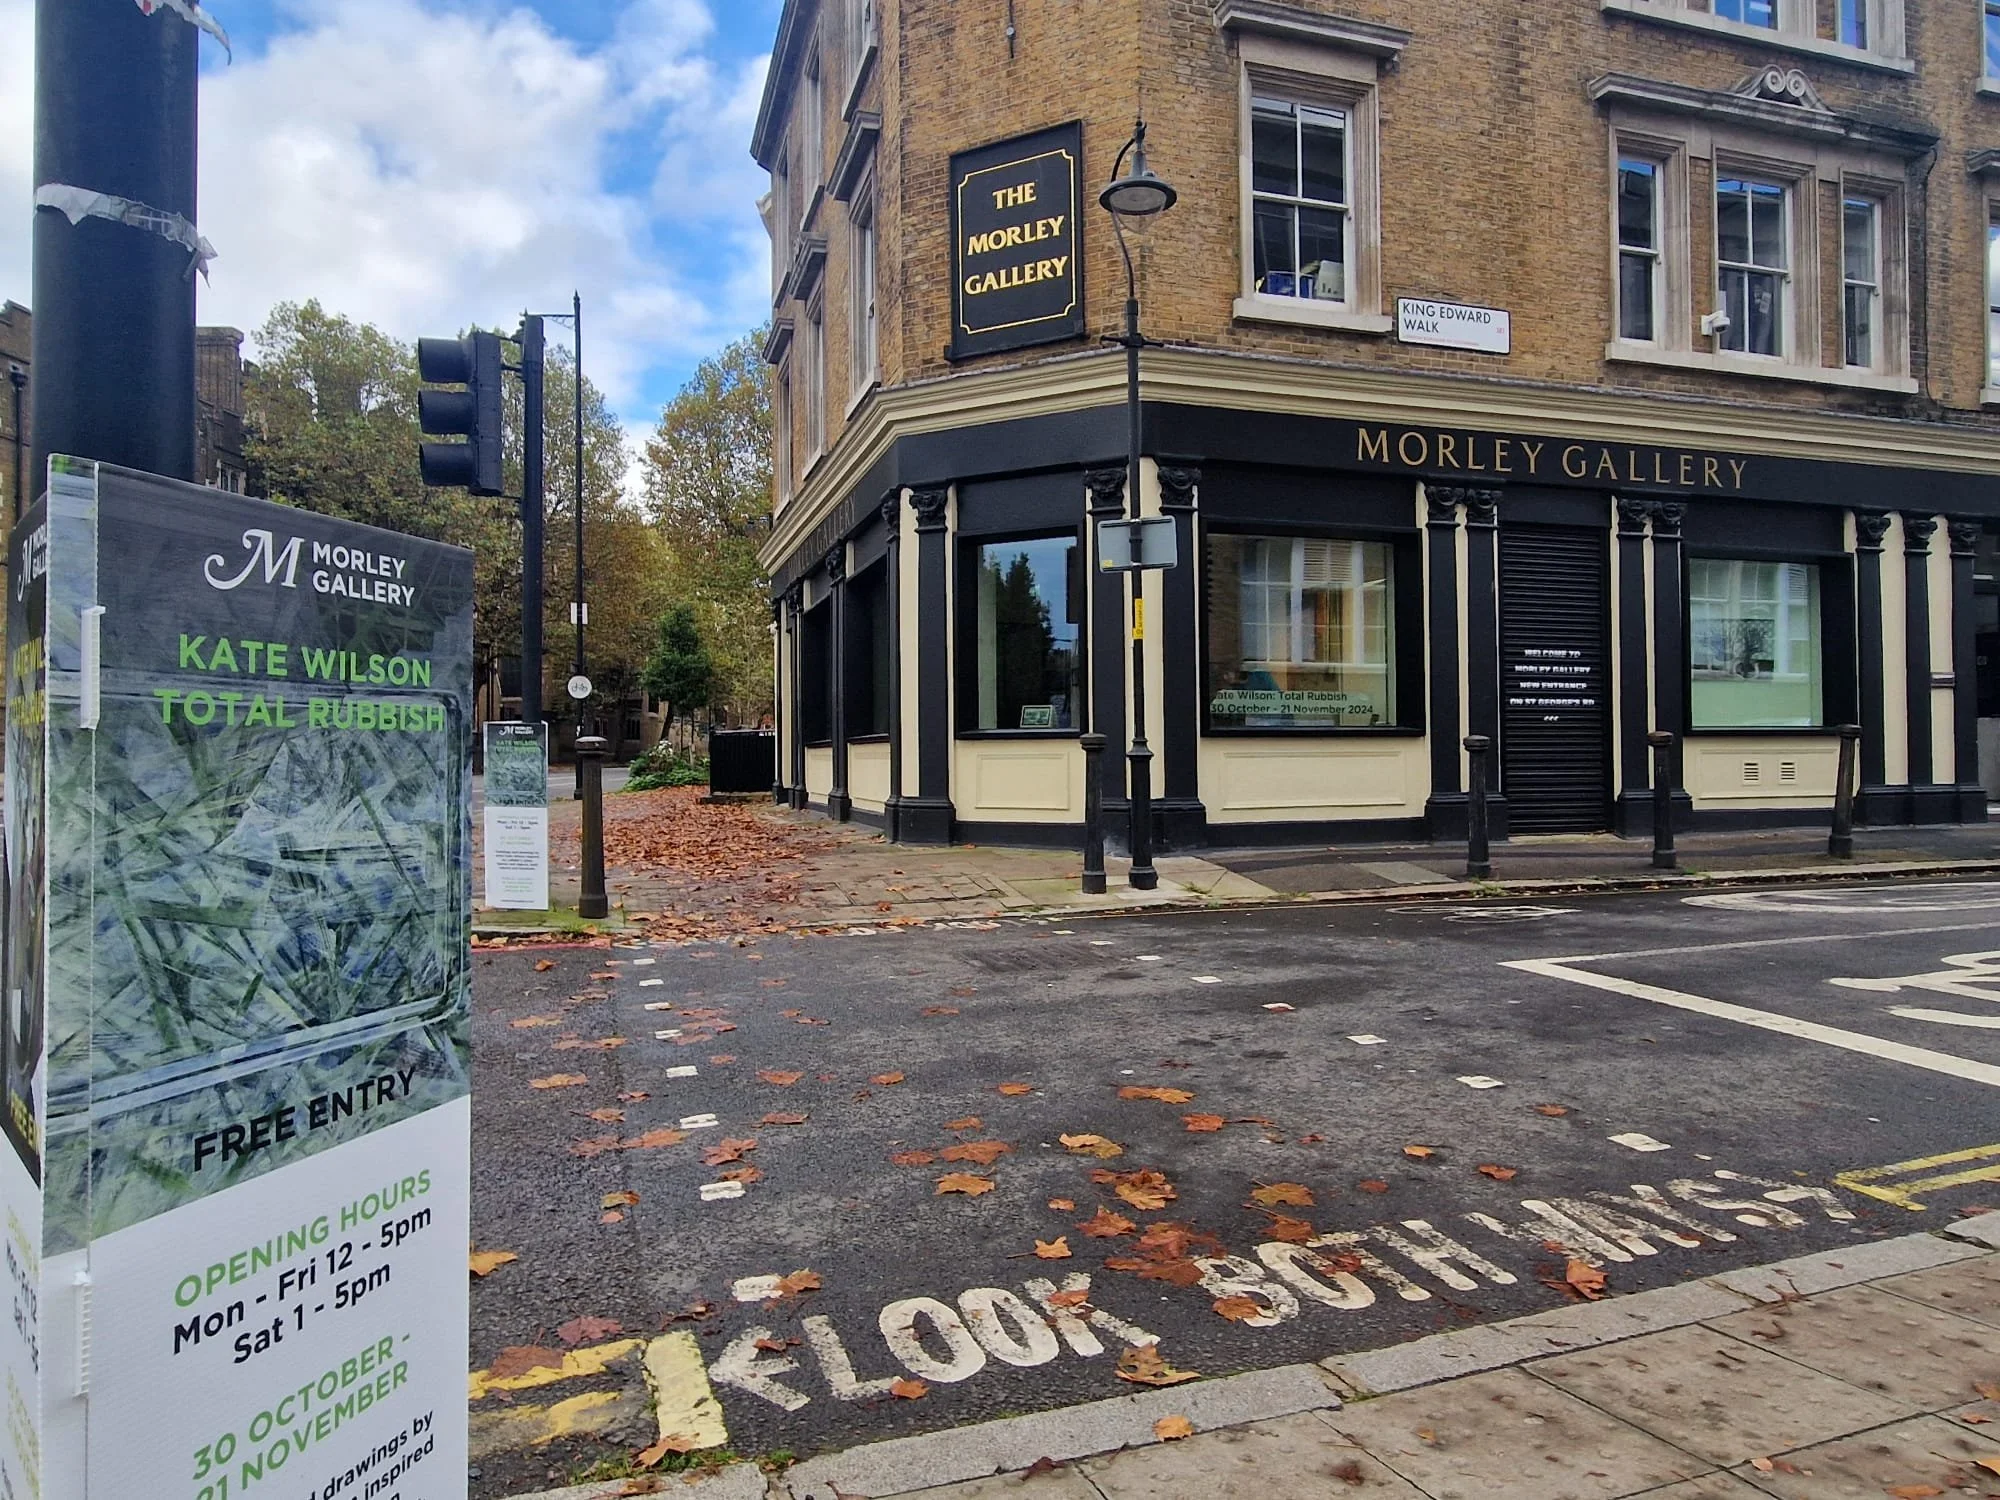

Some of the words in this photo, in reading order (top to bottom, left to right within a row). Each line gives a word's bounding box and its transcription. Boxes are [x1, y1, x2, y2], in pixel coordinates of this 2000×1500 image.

[992, 182, 1037, 210] THE
[967, 215, 1065, 256] MORLEY
[964, 255, 1069, 295] GALLERY
[1403, 302, 1436, 318] KING
[1440, 306, 1491, 324] EDWARD
[1404, 318, 1439, 333] WALK
[1356, 427, 1543, 474] MORLEY
[1561, 444, 1748, 489] GALLERY
[816, 491, 857, 556] GALLERY
[312, 541, 406, 579] MORLEY
[312, 569, 415, 607] GALLERY
[178, 633, 289, 677] KATE
[301, 646, 431, 688] WILSON
[153, 688, 296, 729] TOTAL
[308, 697, 444, 733] RUBBISH
[1211, 703, 1225, 713] 30
[1228, 704, 1270, 713] October
[1280, 704, 1291, 713] 21
[1294, 704, 1345, 714] November
[1349, 705, 1374, 714] 2024
[1217, 692, 1234, 700] ate
[1238, 691, 1276, 700] Wilson:
[1279, 691, 1304, 700] Total
[1307, 691, 1348, 701] Rubbish
[193, 1106, 296, 1172] FREE
[308, 1066, 416, 1131] ENTRY
[174, 1215, 329, 1307] OPENING
[340, 1168, 431, 1231] HOURS
[173, 1300, 244, 1354] Mon
[278, 1257, 316, 1301] Fri
[325, 1242, 353, 1275] 12
[380, 1207, 432, 1248] 5pm
[233, 1317, 284, 1364] Sat
[293, 1303, 304, 1331] 1
[334, 1263, 391, 1310] 5pm
[803, 1273, 1160, 1402] LOOK
[1194, 1218, 1518, 1327] BOTH
[192, 1432, 237, 1480] 30
[248, 1335, 394, 1443] OCTOBER
[241, 1360, 409, 1490] NOVEMBER
[322, 1430, 408, 1500] drawings
[412, 1410, 433, 1437] by
[364, 1433, 434, 1500] inspired
